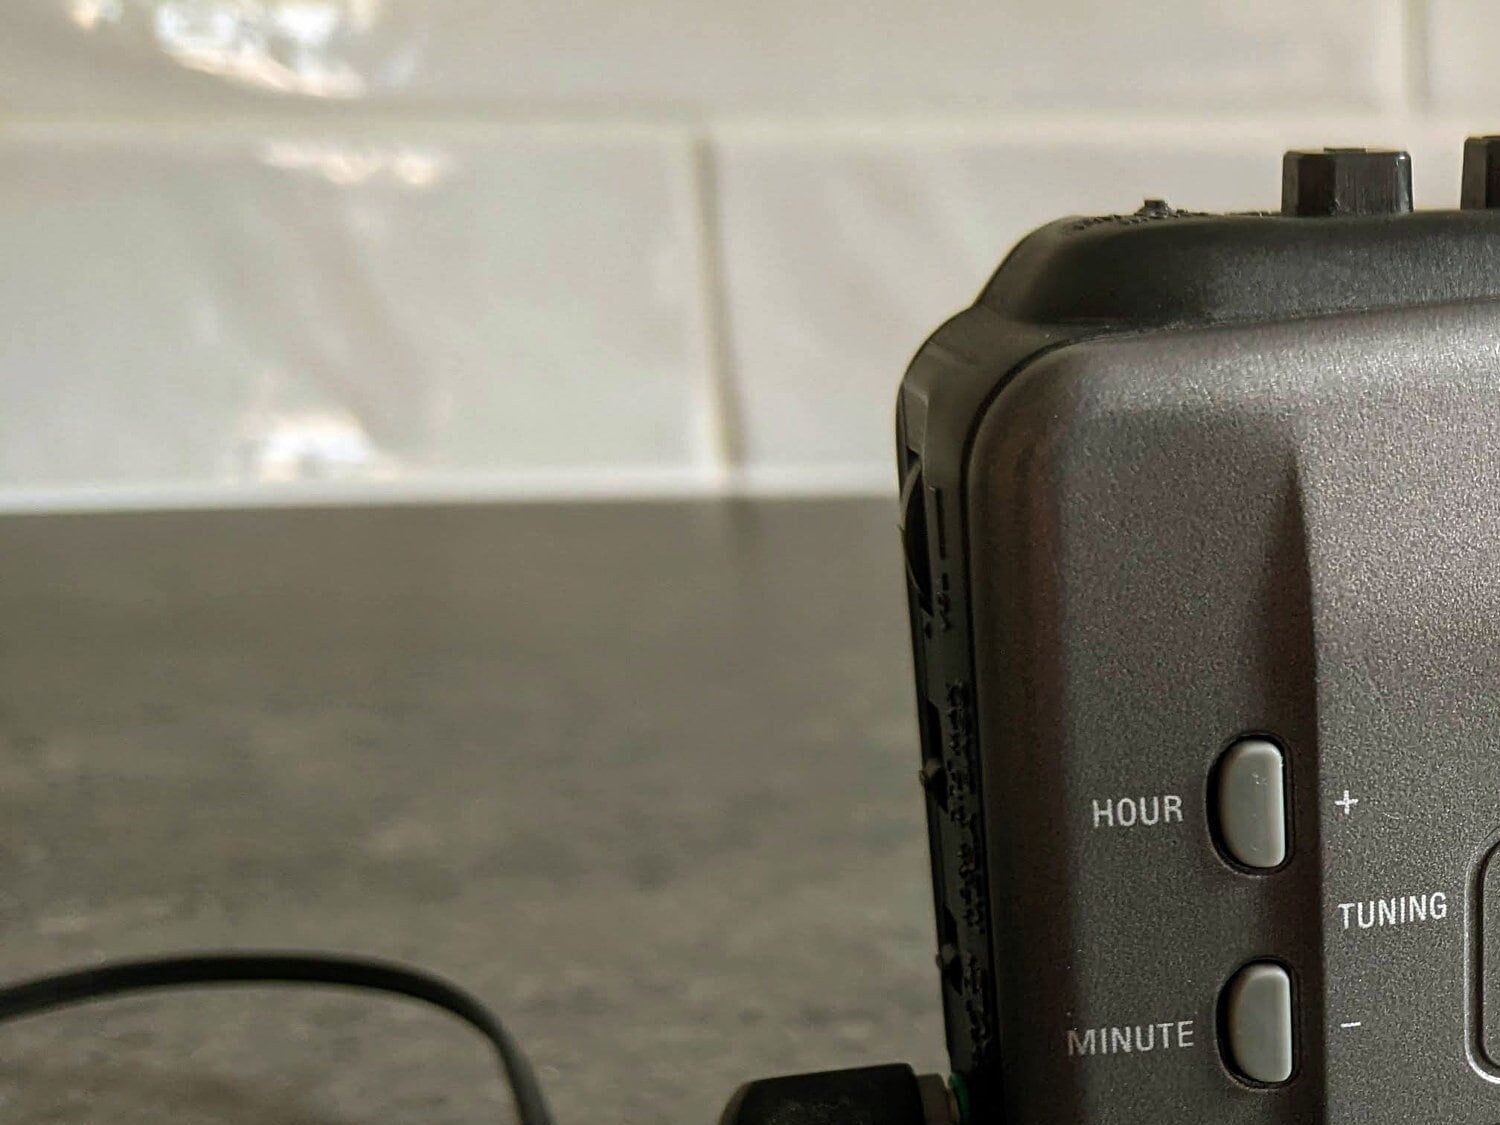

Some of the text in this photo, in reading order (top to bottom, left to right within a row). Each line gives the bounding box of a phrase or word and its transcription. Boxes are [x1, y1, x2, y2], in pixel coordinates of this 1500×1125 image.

[1093, 795, 1183, 828] HOUR
[1338, 892, 1447, 930] TUNING
[1067, 1020, 1194, 1057] MINUTE
